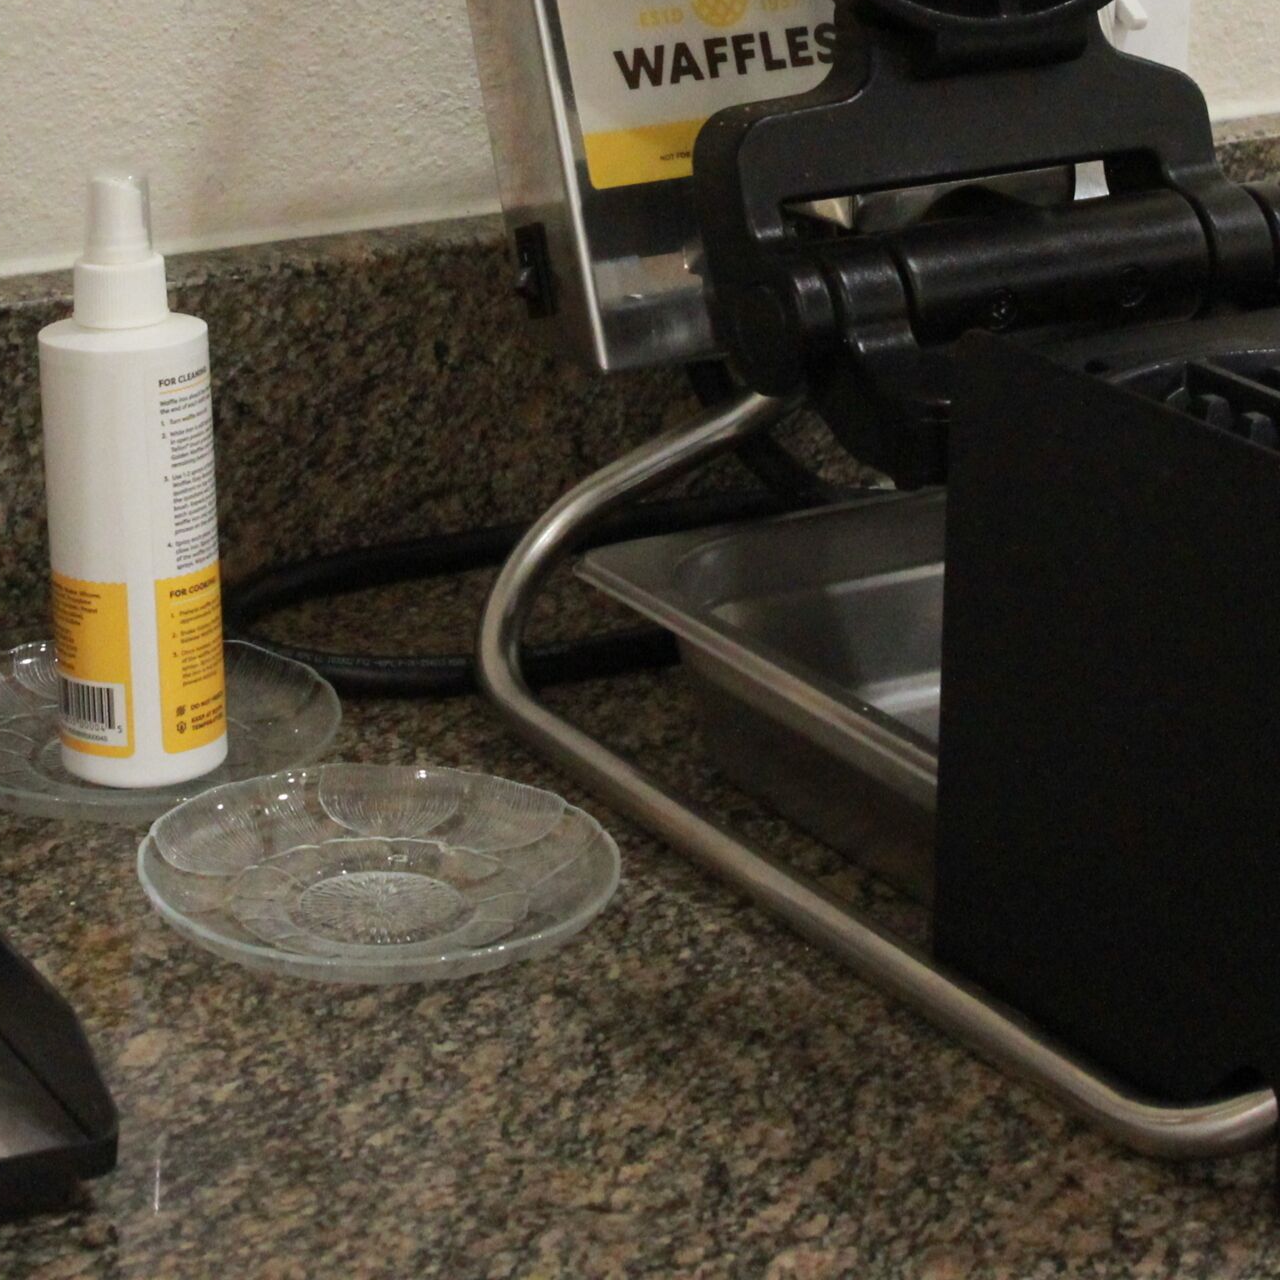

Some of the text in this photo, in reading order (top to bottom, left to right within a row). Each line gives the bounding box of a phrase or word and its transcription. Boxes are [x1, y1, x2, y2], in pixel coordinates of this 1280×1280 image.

[613, 22, 836, 91] WAFFLES
[158, 377, 176, 388] FOR
[169, 586, 187, 598] FOR
